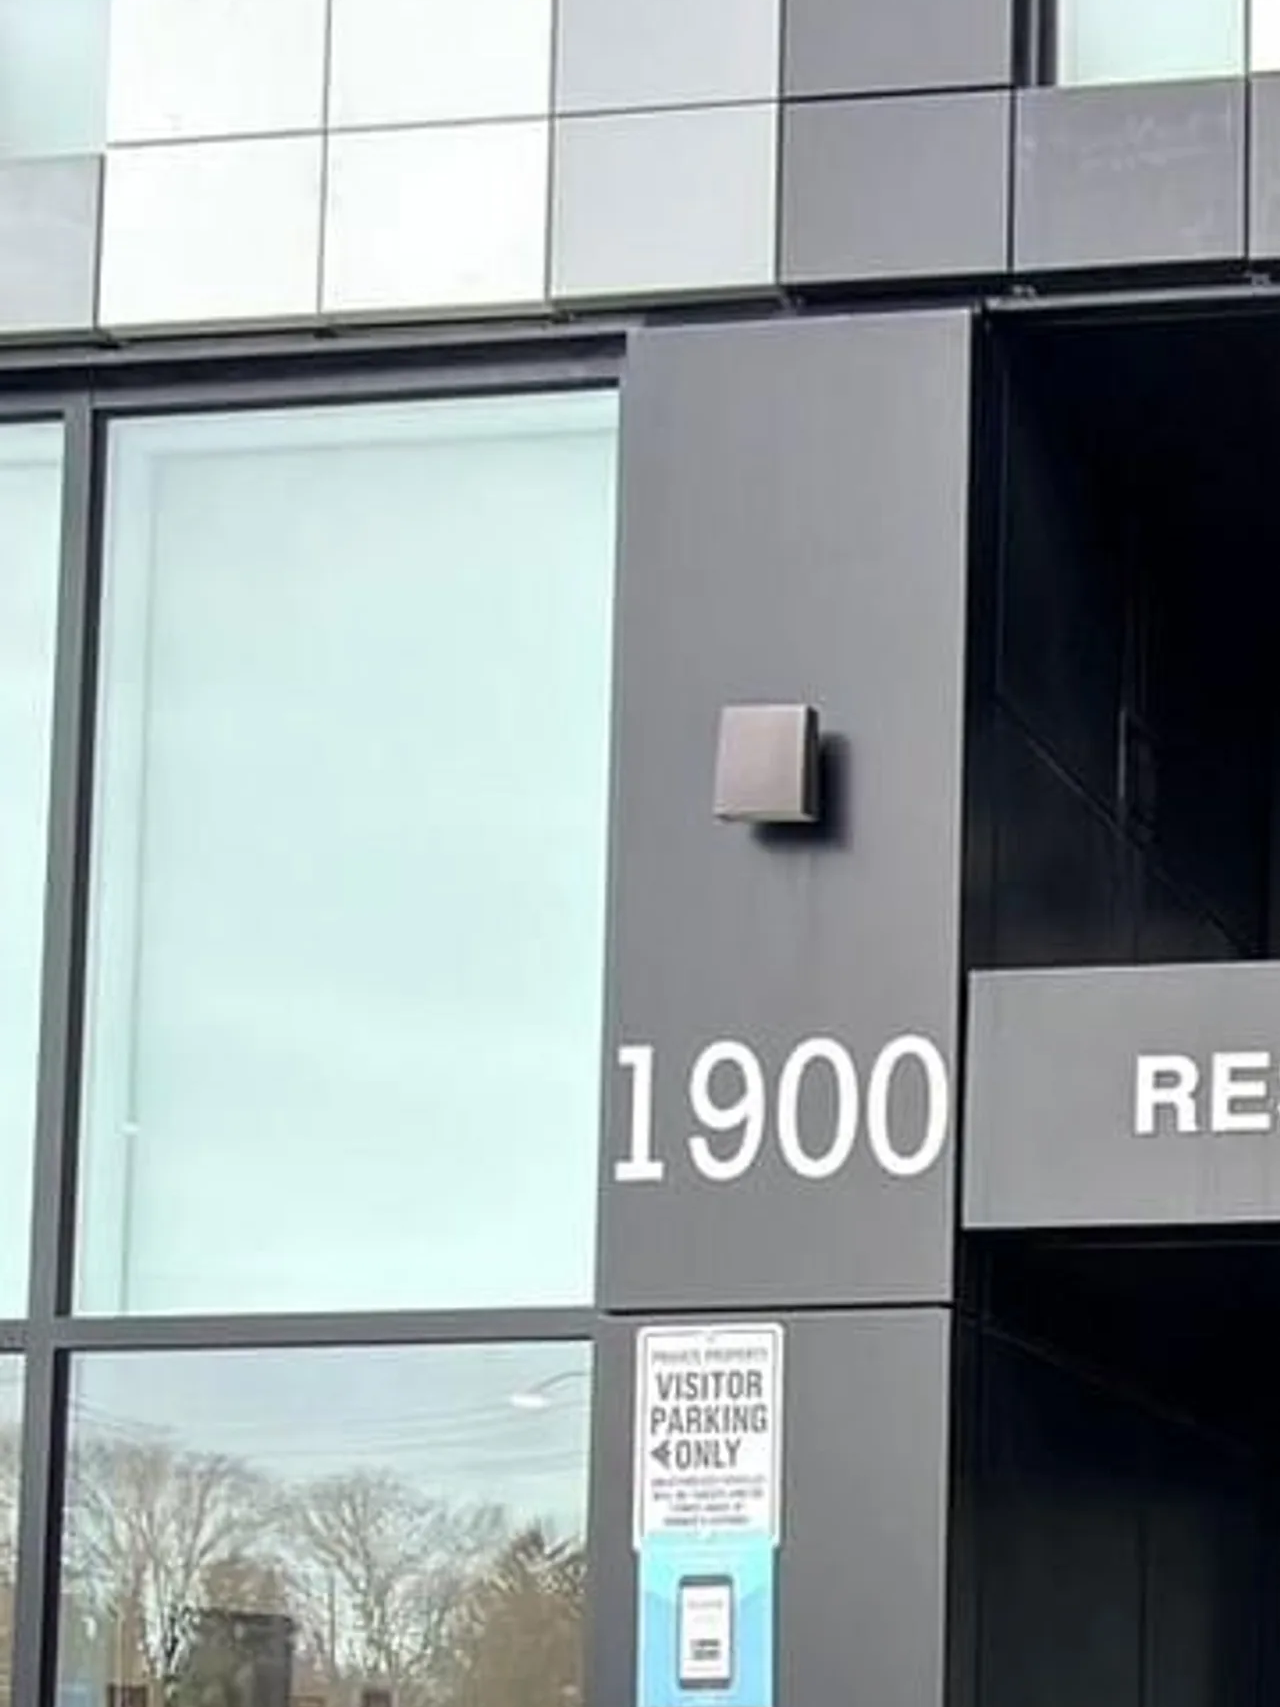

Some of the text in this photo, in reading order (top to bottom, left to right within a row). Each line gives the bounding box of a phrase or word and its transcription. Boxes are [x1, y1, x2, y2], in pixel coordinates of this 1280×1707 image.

[614, 1034, 949, 1182] 1900
[655, 1370, 763, 1401] VISITOR
[650, 1403, 769, 1435] PARKING
[675, 1438, 742, 1470] ONLY
